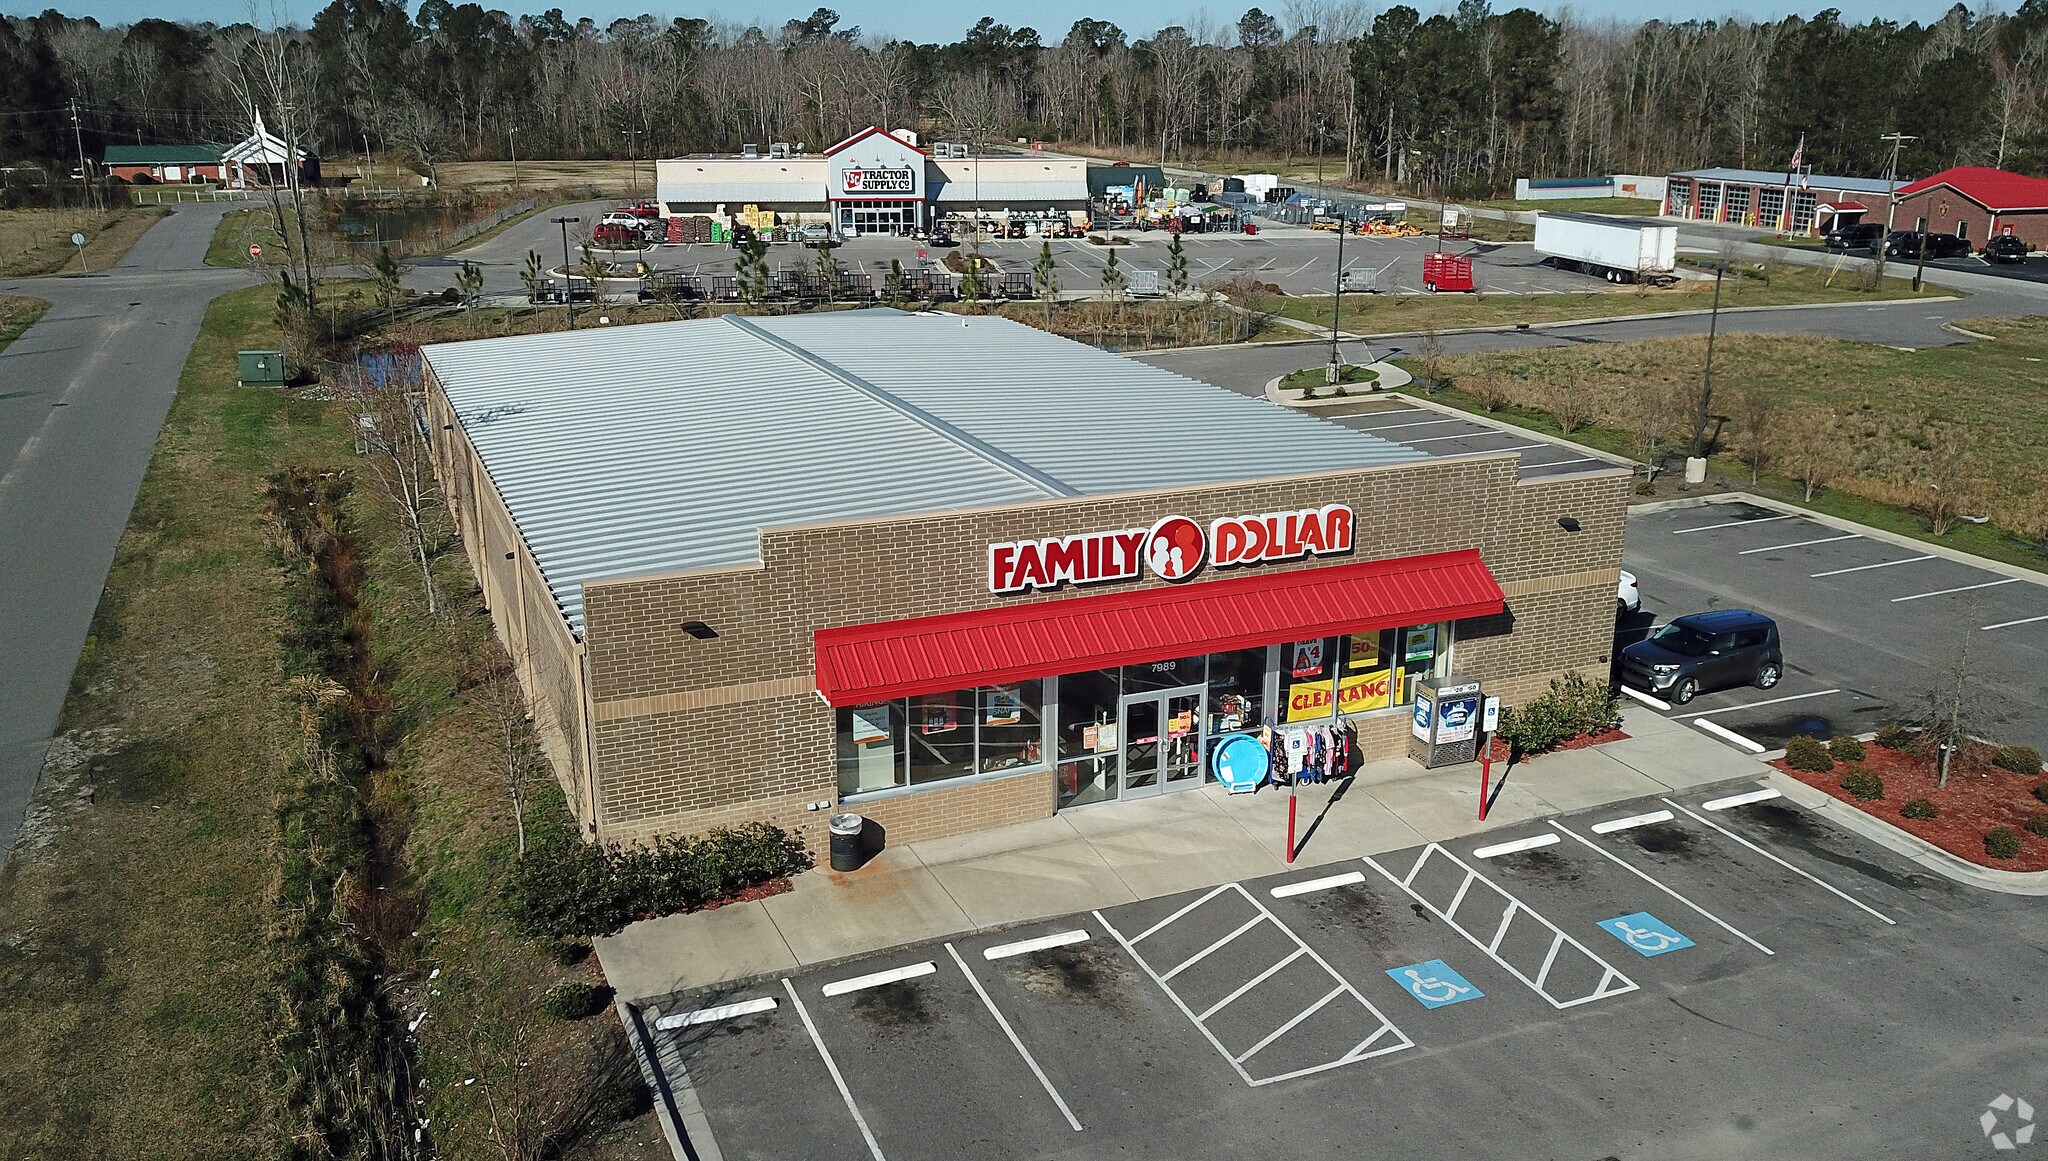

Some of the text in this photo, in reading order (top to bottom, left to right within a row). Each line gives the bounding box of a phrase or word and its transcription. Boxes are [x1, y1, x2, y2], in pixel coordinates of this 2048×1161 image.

[845, 172, 860, 185] TSC
[862, 171, 909, 179] TRACTOR
[862, 180, 898, 190] SUPPLY
[992, 507, 1353, 591] FAMILY DOLLAR
[1151, 661, 1176, 673] 7989
[1291, 677, 1402, 710] CLEARANC!
